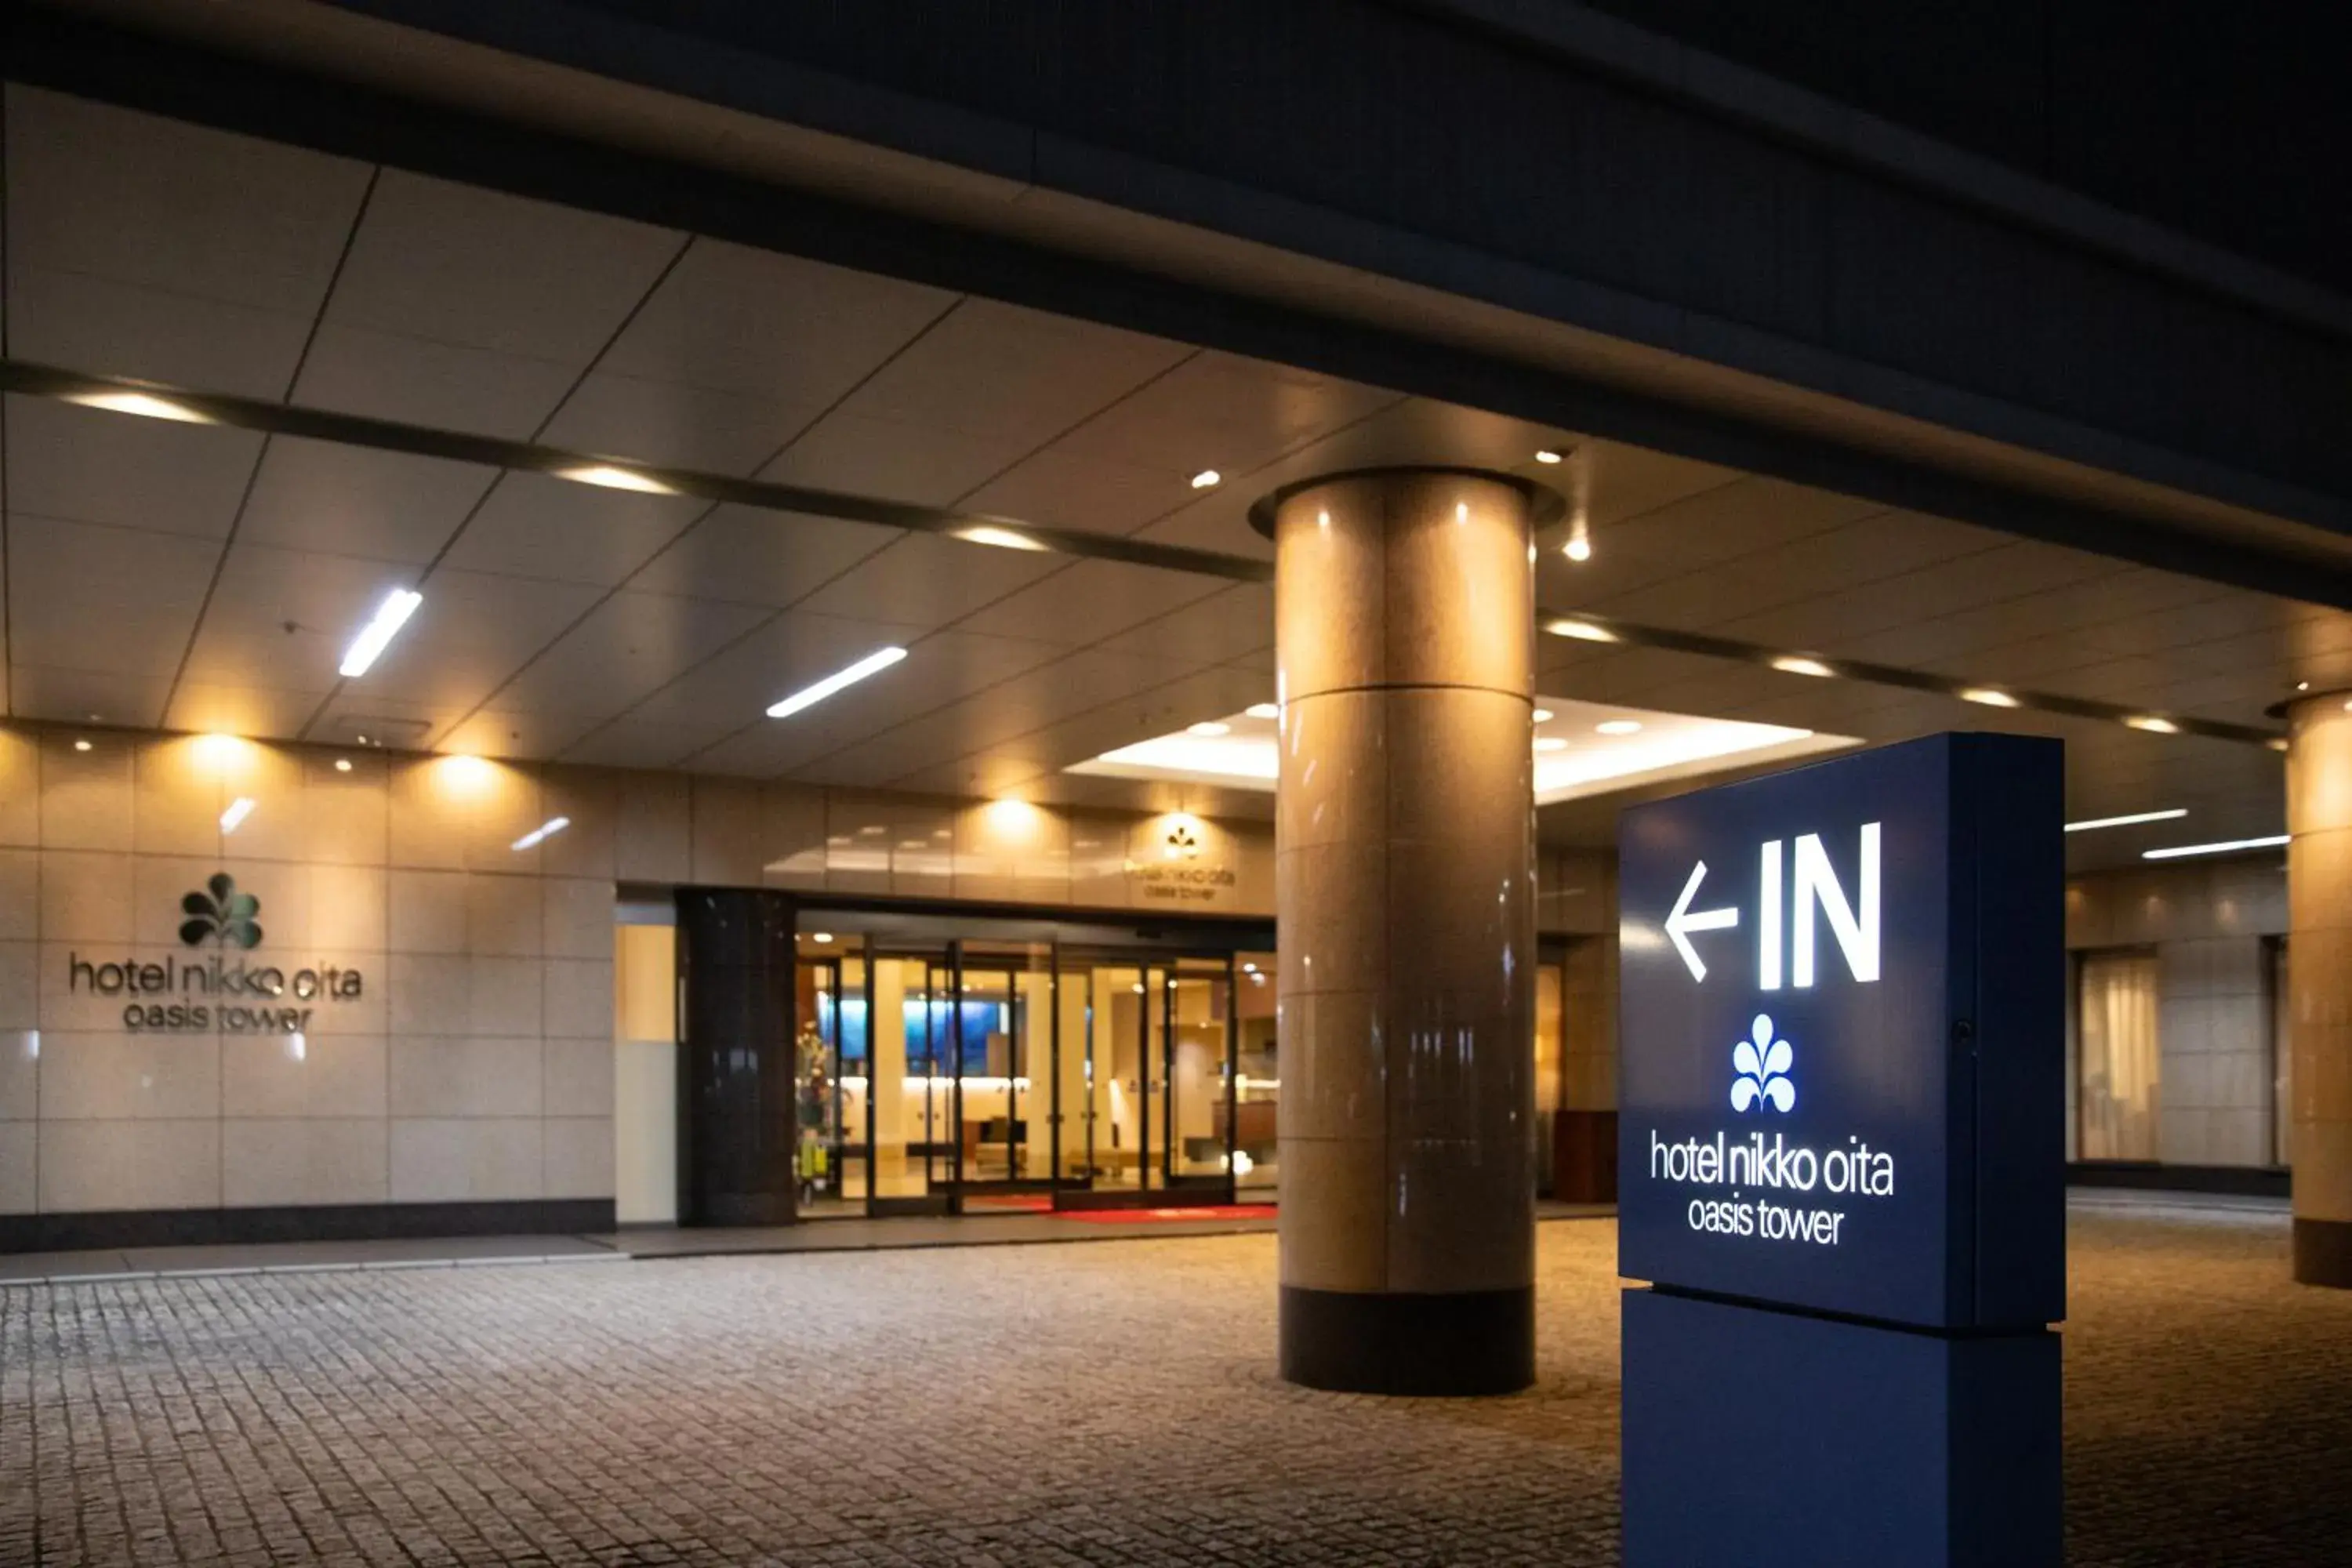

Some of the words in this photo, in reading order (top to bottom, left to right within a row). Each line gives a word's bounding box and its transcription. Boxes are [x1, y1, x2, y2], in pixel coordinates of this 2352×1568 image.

[1760, 822, 1881, 990] IN
[70, 952, 173, 996] hotel
[183, 956, 285, 998] nikko
[292, 959, 363, 1000] oita
[123, 996, 209, 1031] oasis
[216, 1003, 312, 1032] tower
[1651, 1129, 1724, 1184] hotel
[1730, 1132, 1817, 1191] nikko
[1824, 1135, 1893, 1196] oita
[1689, 1192, 1754, 1236] oasis
[1757, 1200, 1844, 1245] tower
